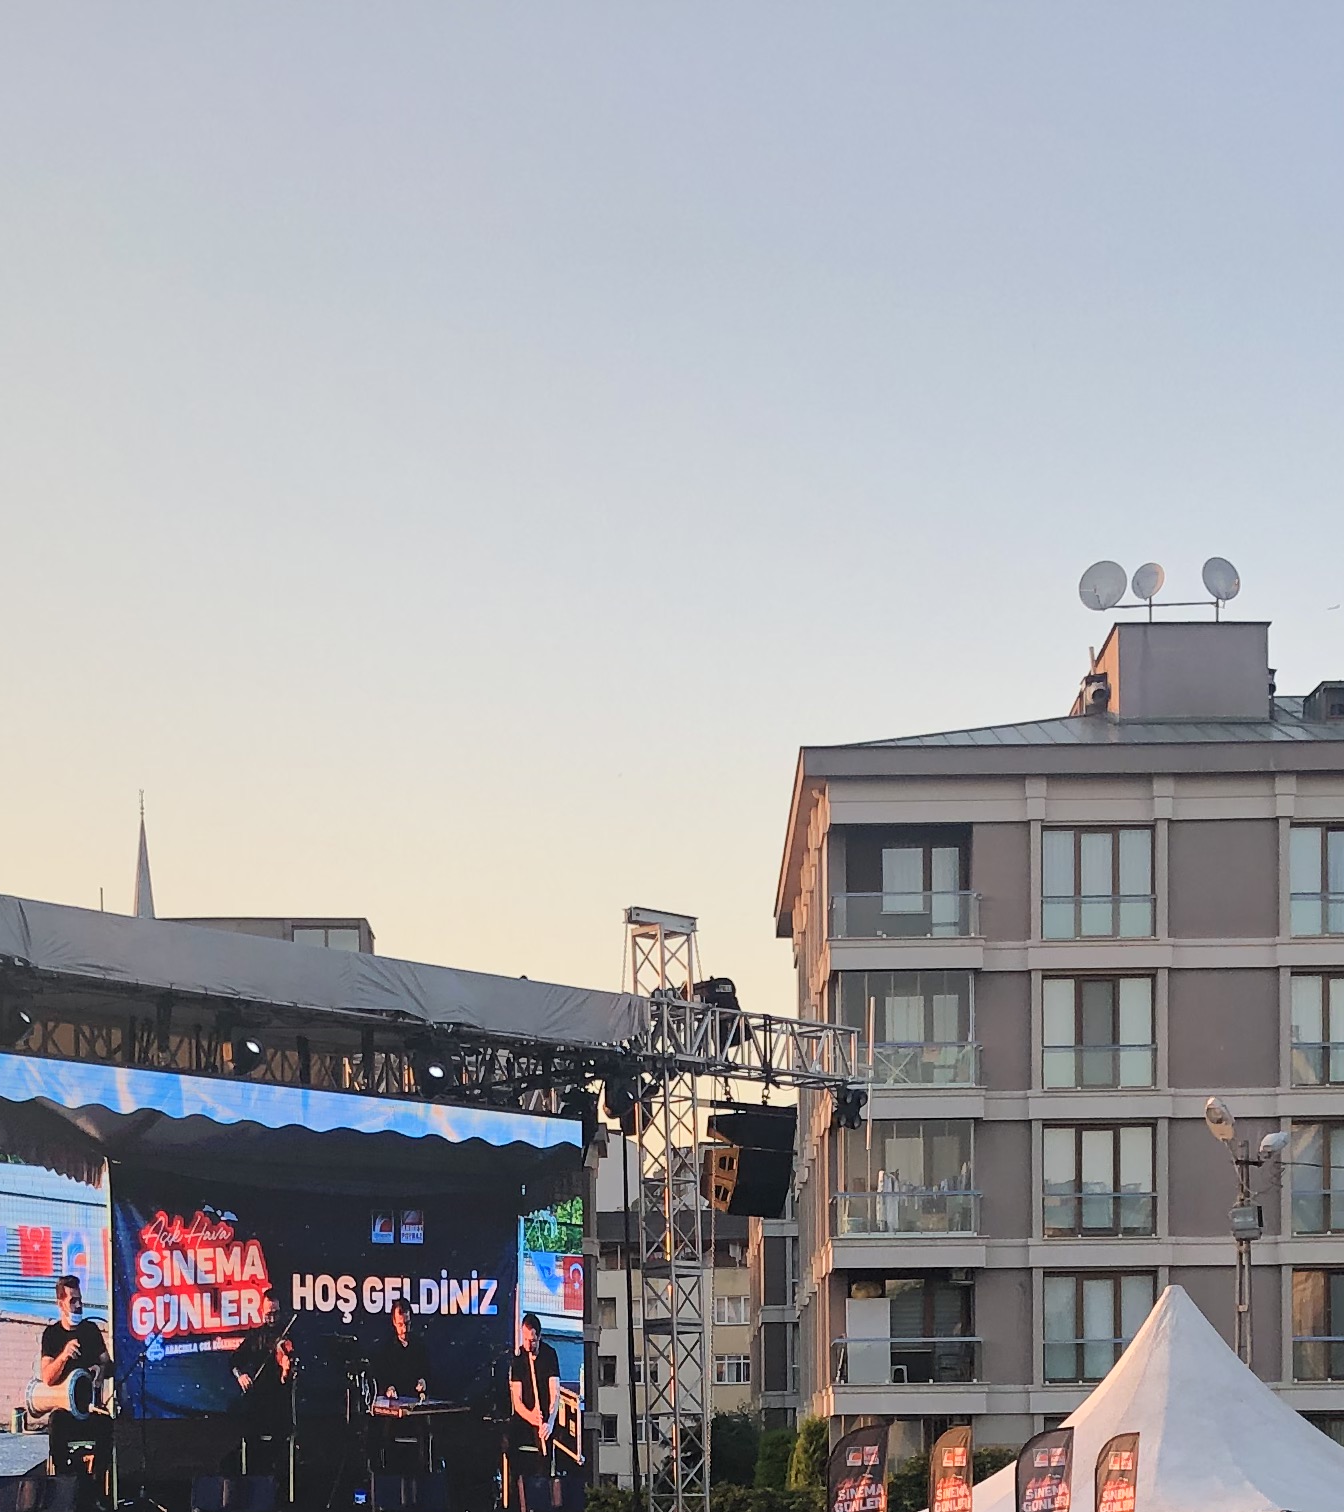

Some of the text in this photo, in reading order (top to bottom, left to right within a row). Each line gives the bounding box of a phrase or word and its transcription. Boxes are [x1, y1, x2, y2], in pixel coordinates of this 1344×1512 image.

[182, 1216, 231, 1249] Hava
[139, 1245, 265, 1289] SİNEMA
[131, 1288, 268, 1336] GÜNLER
[292, 1268, 498, 1324] HOŞ GELDİNİZ
